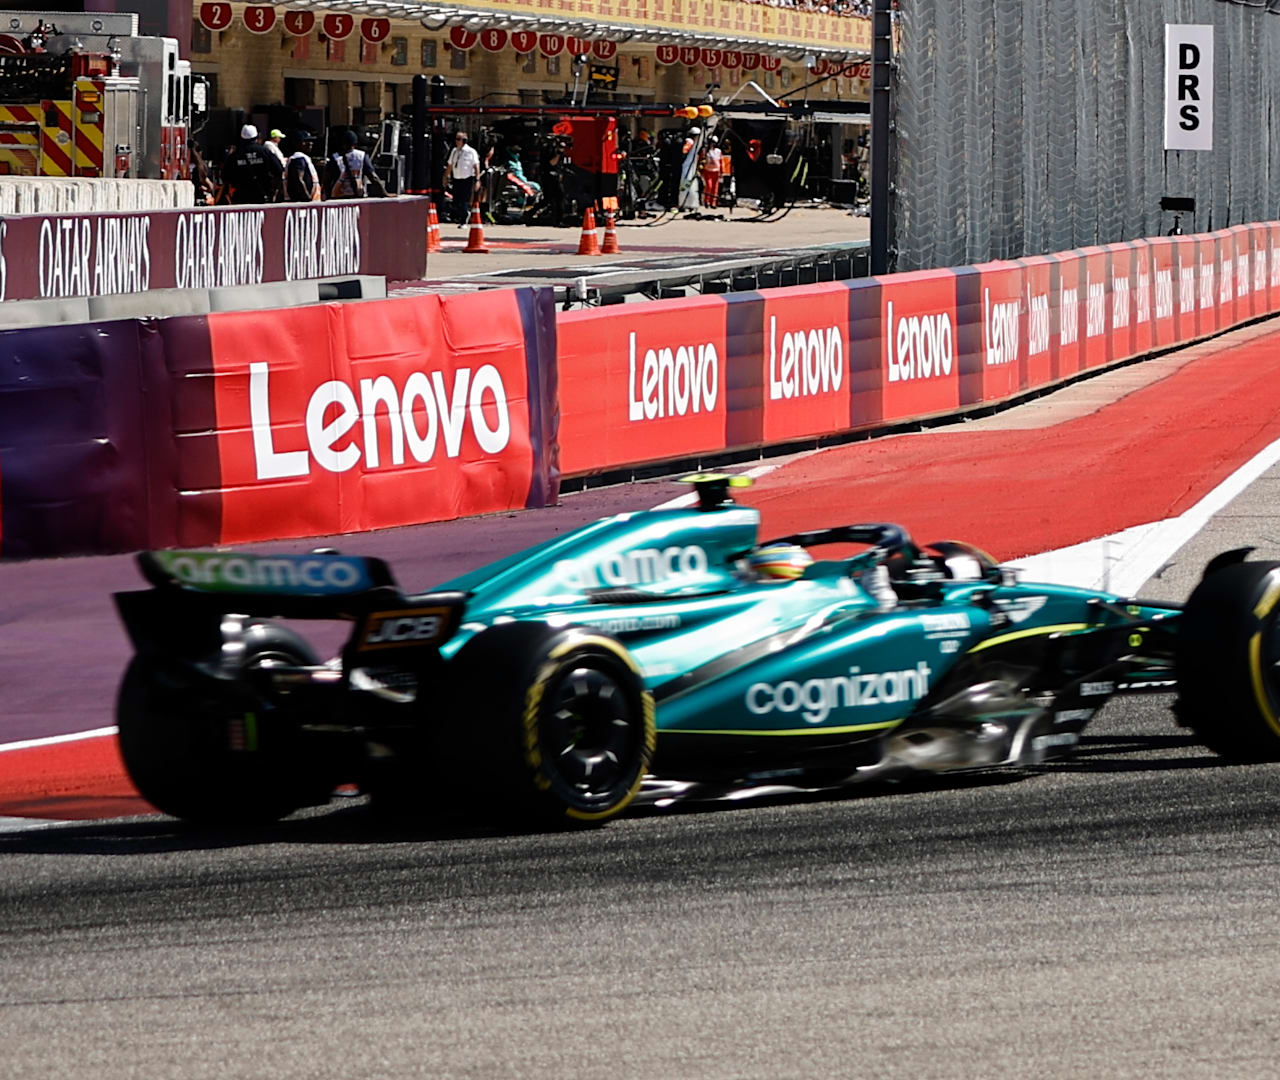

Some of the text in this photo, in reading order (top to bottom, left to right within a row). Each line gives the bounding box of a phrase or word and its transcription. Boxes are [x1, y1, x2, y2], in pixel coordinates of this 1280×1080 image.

[545, 36, 559, 52] 10
[573, 38, 585, 54] 11
[598, 41, 611, 56] 12
[661, 46, 674, 60] 13
[684, 49, 695, 62] 14
[706, 50, 717, 64] 15
[727, 52, 737, 66] 16
[745, 54, 756, 67] 17
[765, 55, 776, 69] 18
[1178, 43, 1200, 131] DRS
[94, 216, 150, 294] AIRWAYS
[217, 210, 265, 286] AIRWAYS
[319, 206, 361, 274] AIRWAYS
[887, 300, 953, 383] Lenovo
[770, 315, 843, 401] Lenovo
[629, 332, 718, 421] Lenovo
[249, 360, 511, 480] Lenovo
[169, 557, 361, 588] aramco
[563, 545, 708, 588] aramco
[369, 616, 440, 643] JCB
[745, 660, 932, 724] cognizant
